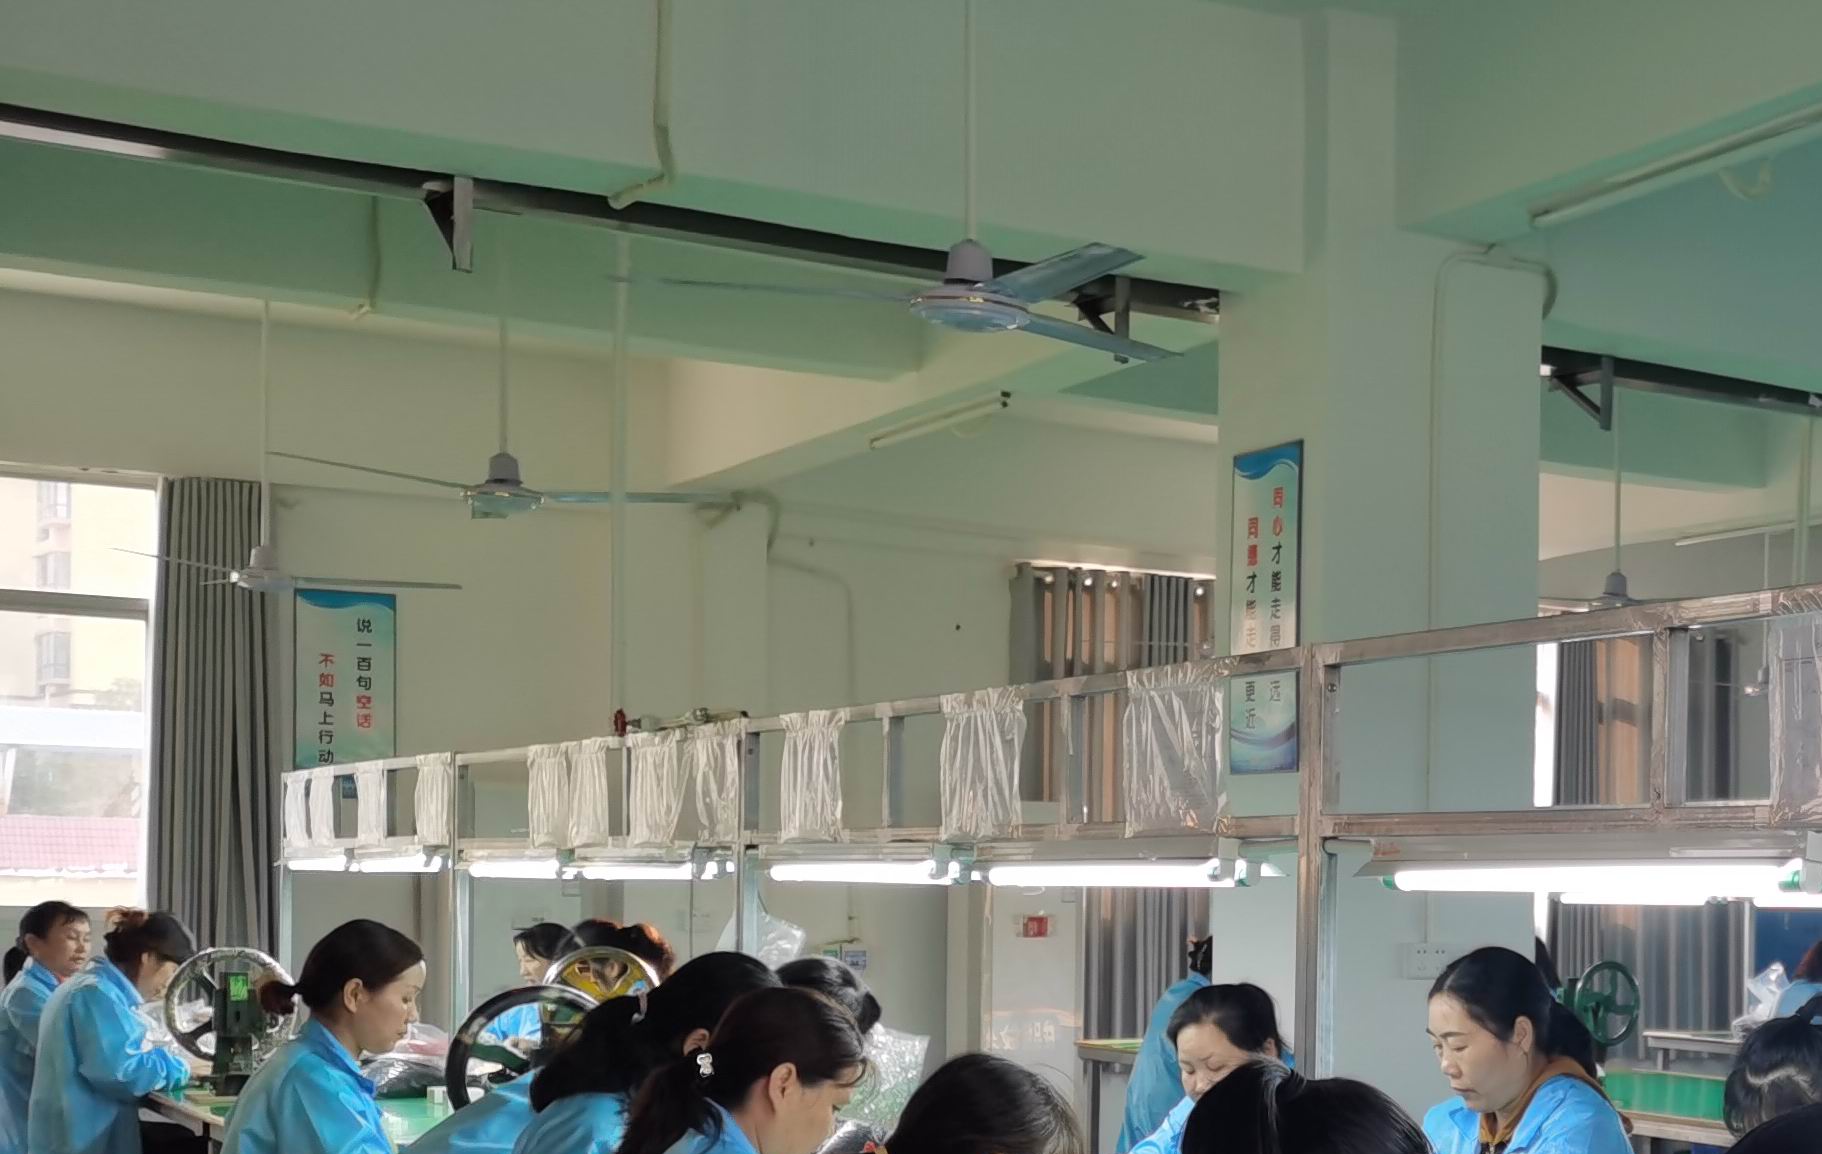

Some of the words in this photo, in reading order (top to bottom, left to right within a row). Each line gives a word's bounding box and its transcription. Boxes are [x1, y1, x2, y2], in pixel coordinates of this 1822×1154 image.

[318, 652, 336, 765] 不如马上行动
[356, 617, 374, 729] 说一百句空话
